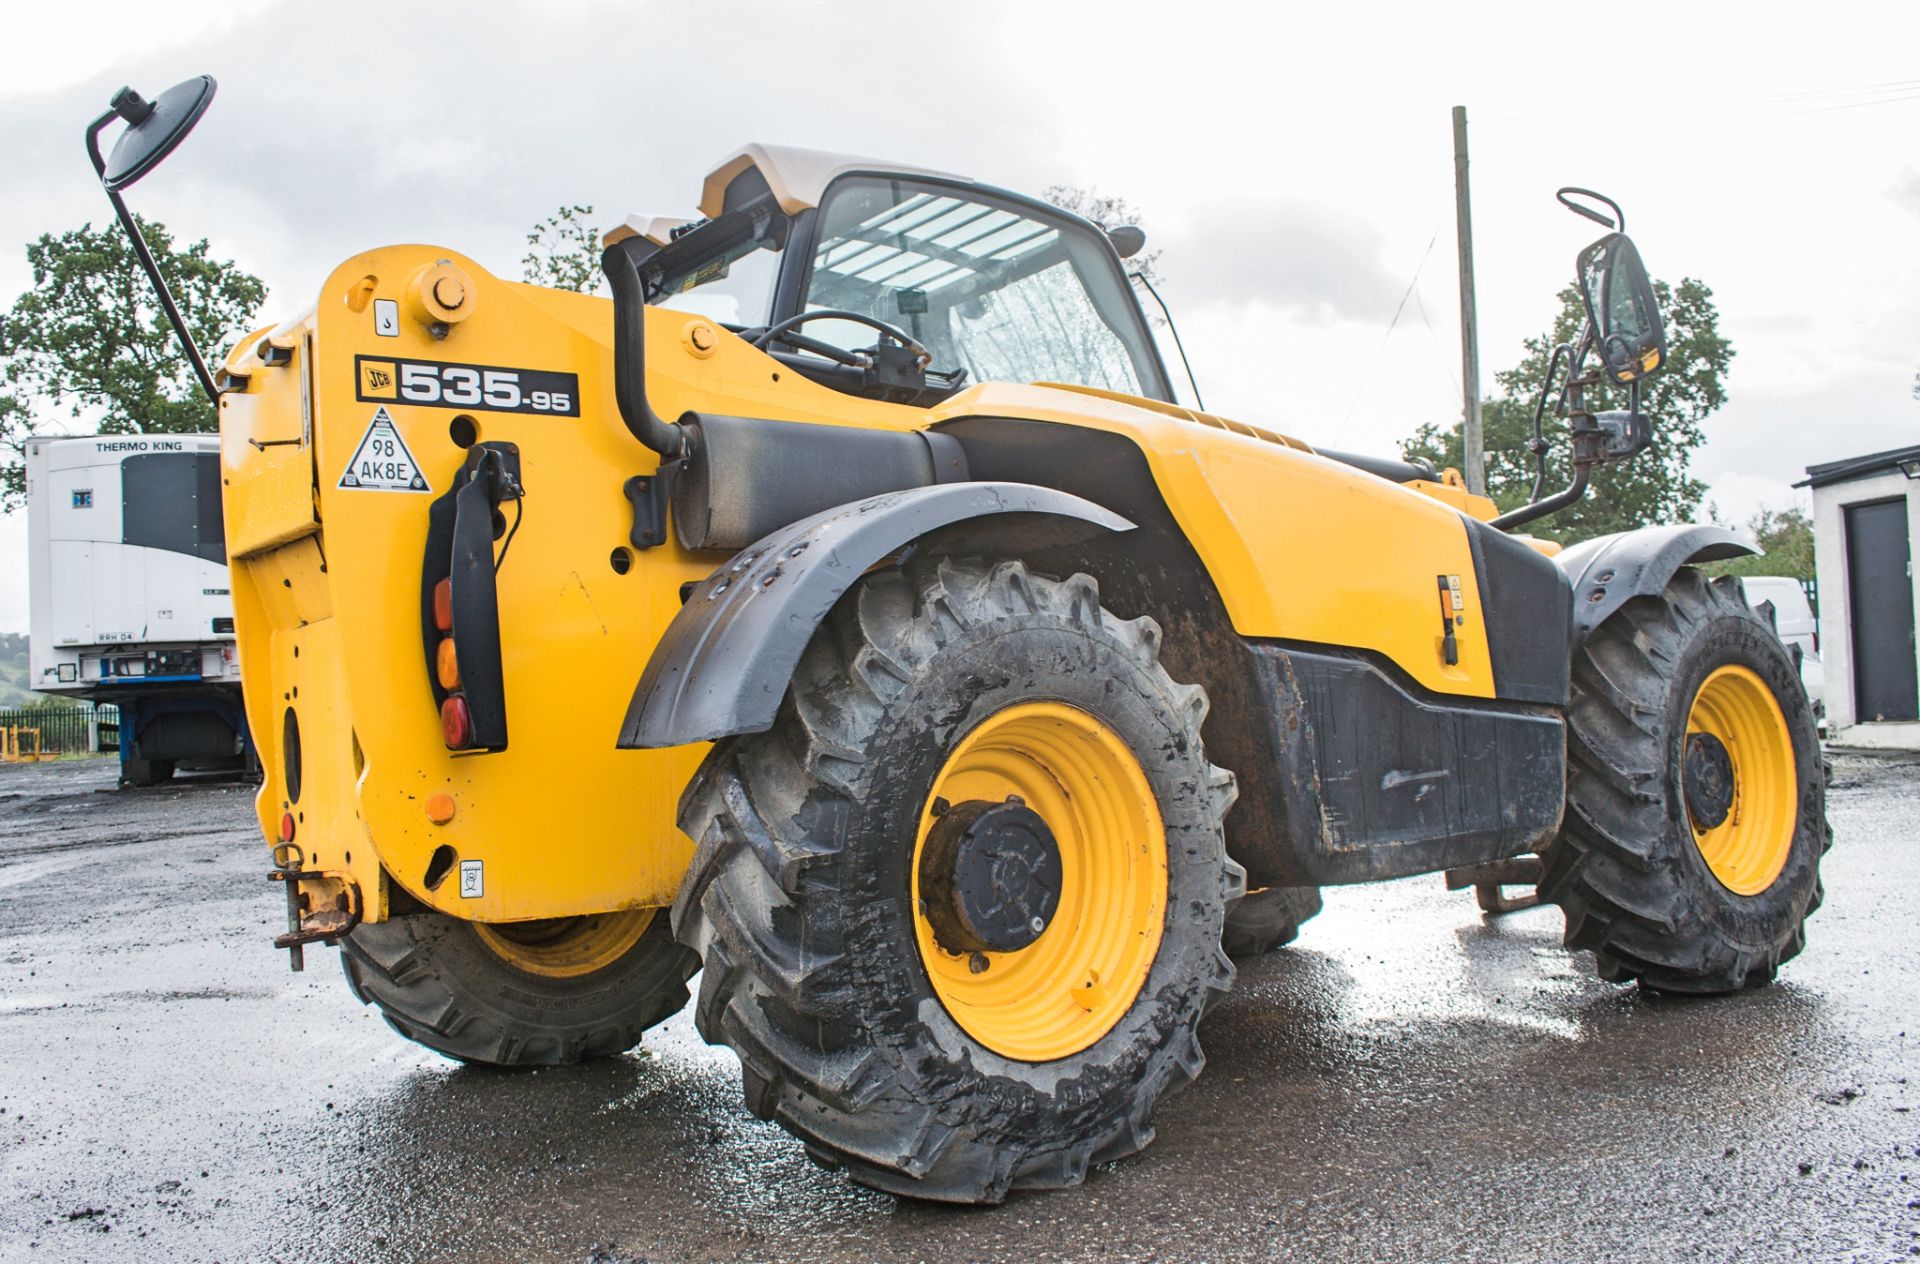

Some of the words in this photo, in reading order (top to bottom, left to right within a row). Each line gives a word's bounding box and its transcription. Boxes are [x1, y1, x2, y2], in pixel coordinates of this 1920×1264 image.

[369, 370, 390, 388] JCB
[401, 363, 571, 412] 535-95
[96, 441, 148, 452] THERMO
[153, 441, 183, 451] KING
[372, 439, 395, 457] 98
[361, 461, 409, 480] AK8E
